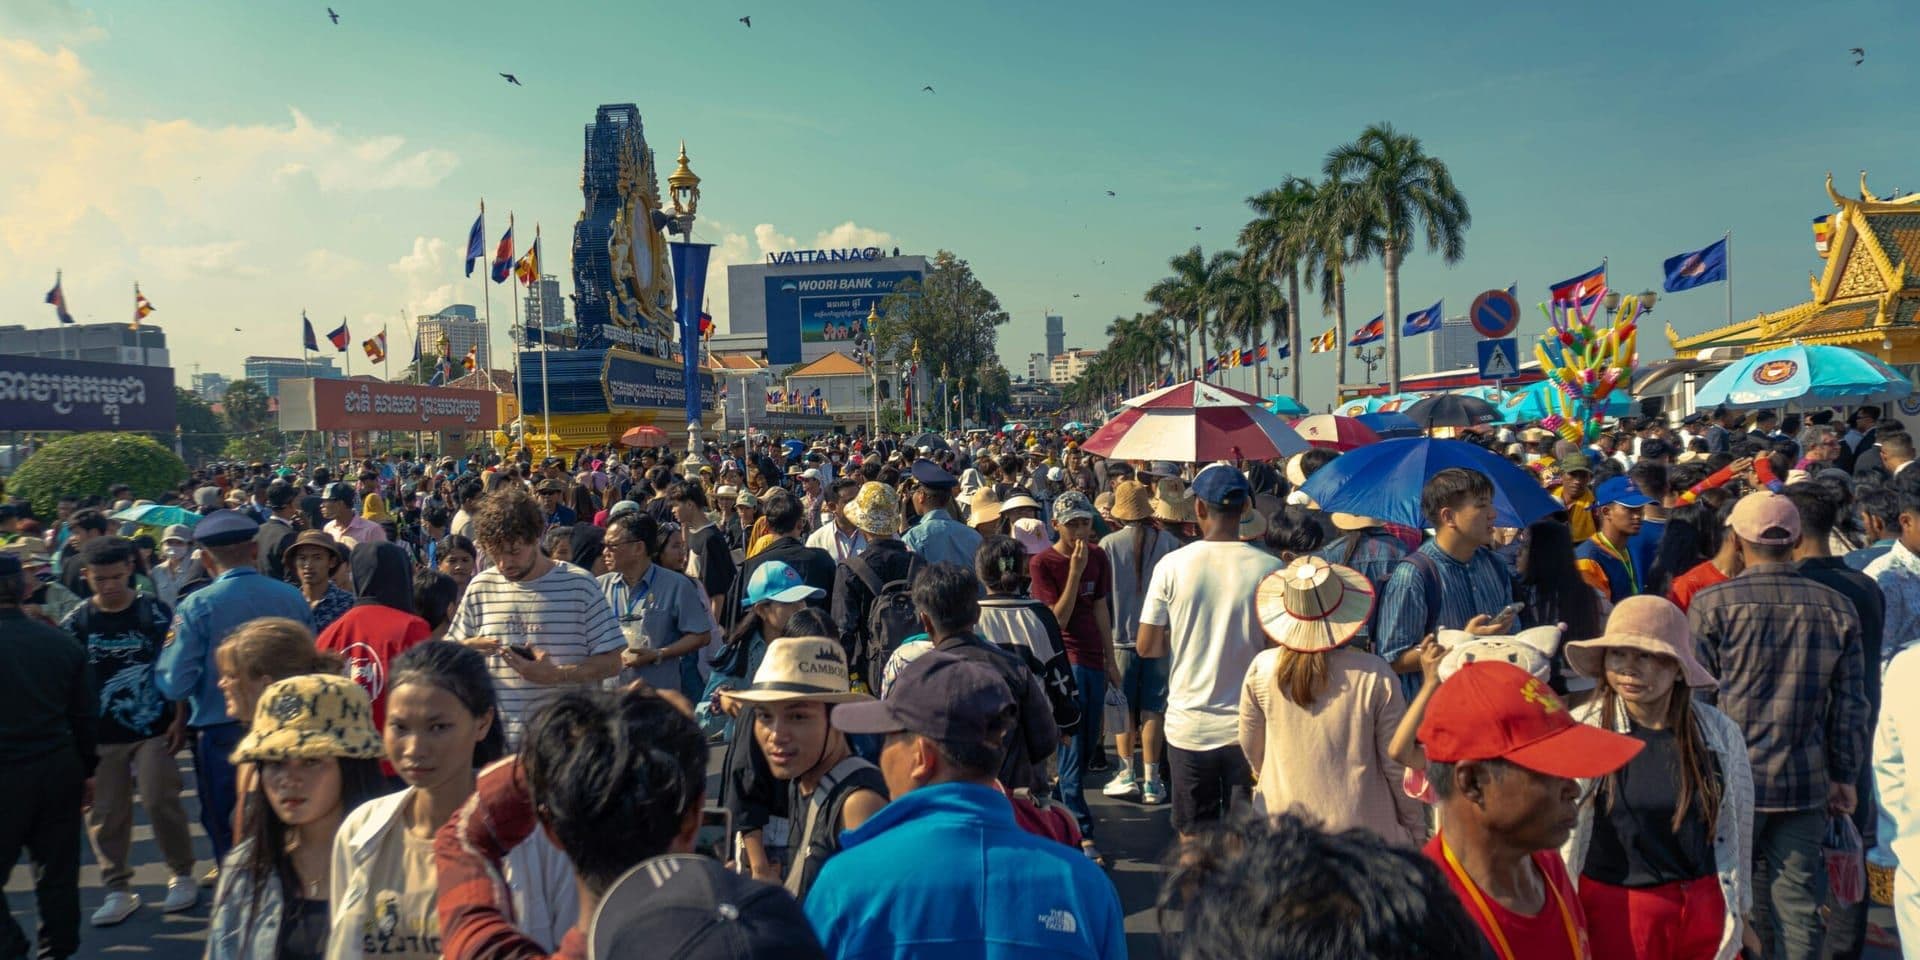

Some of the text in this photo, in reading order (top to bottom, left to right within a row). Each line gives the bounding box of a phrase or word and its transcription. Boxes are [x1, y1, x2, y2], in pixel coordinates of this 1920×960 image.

[769, 247, 880, 265] VATTANAC
[799, 280, 836, 291] WOORI
[839, 278, 873, 290] BANK
[344, 384, 481, 423] ជាតិ សាសនា ព្រះមហាក្សត្រ
